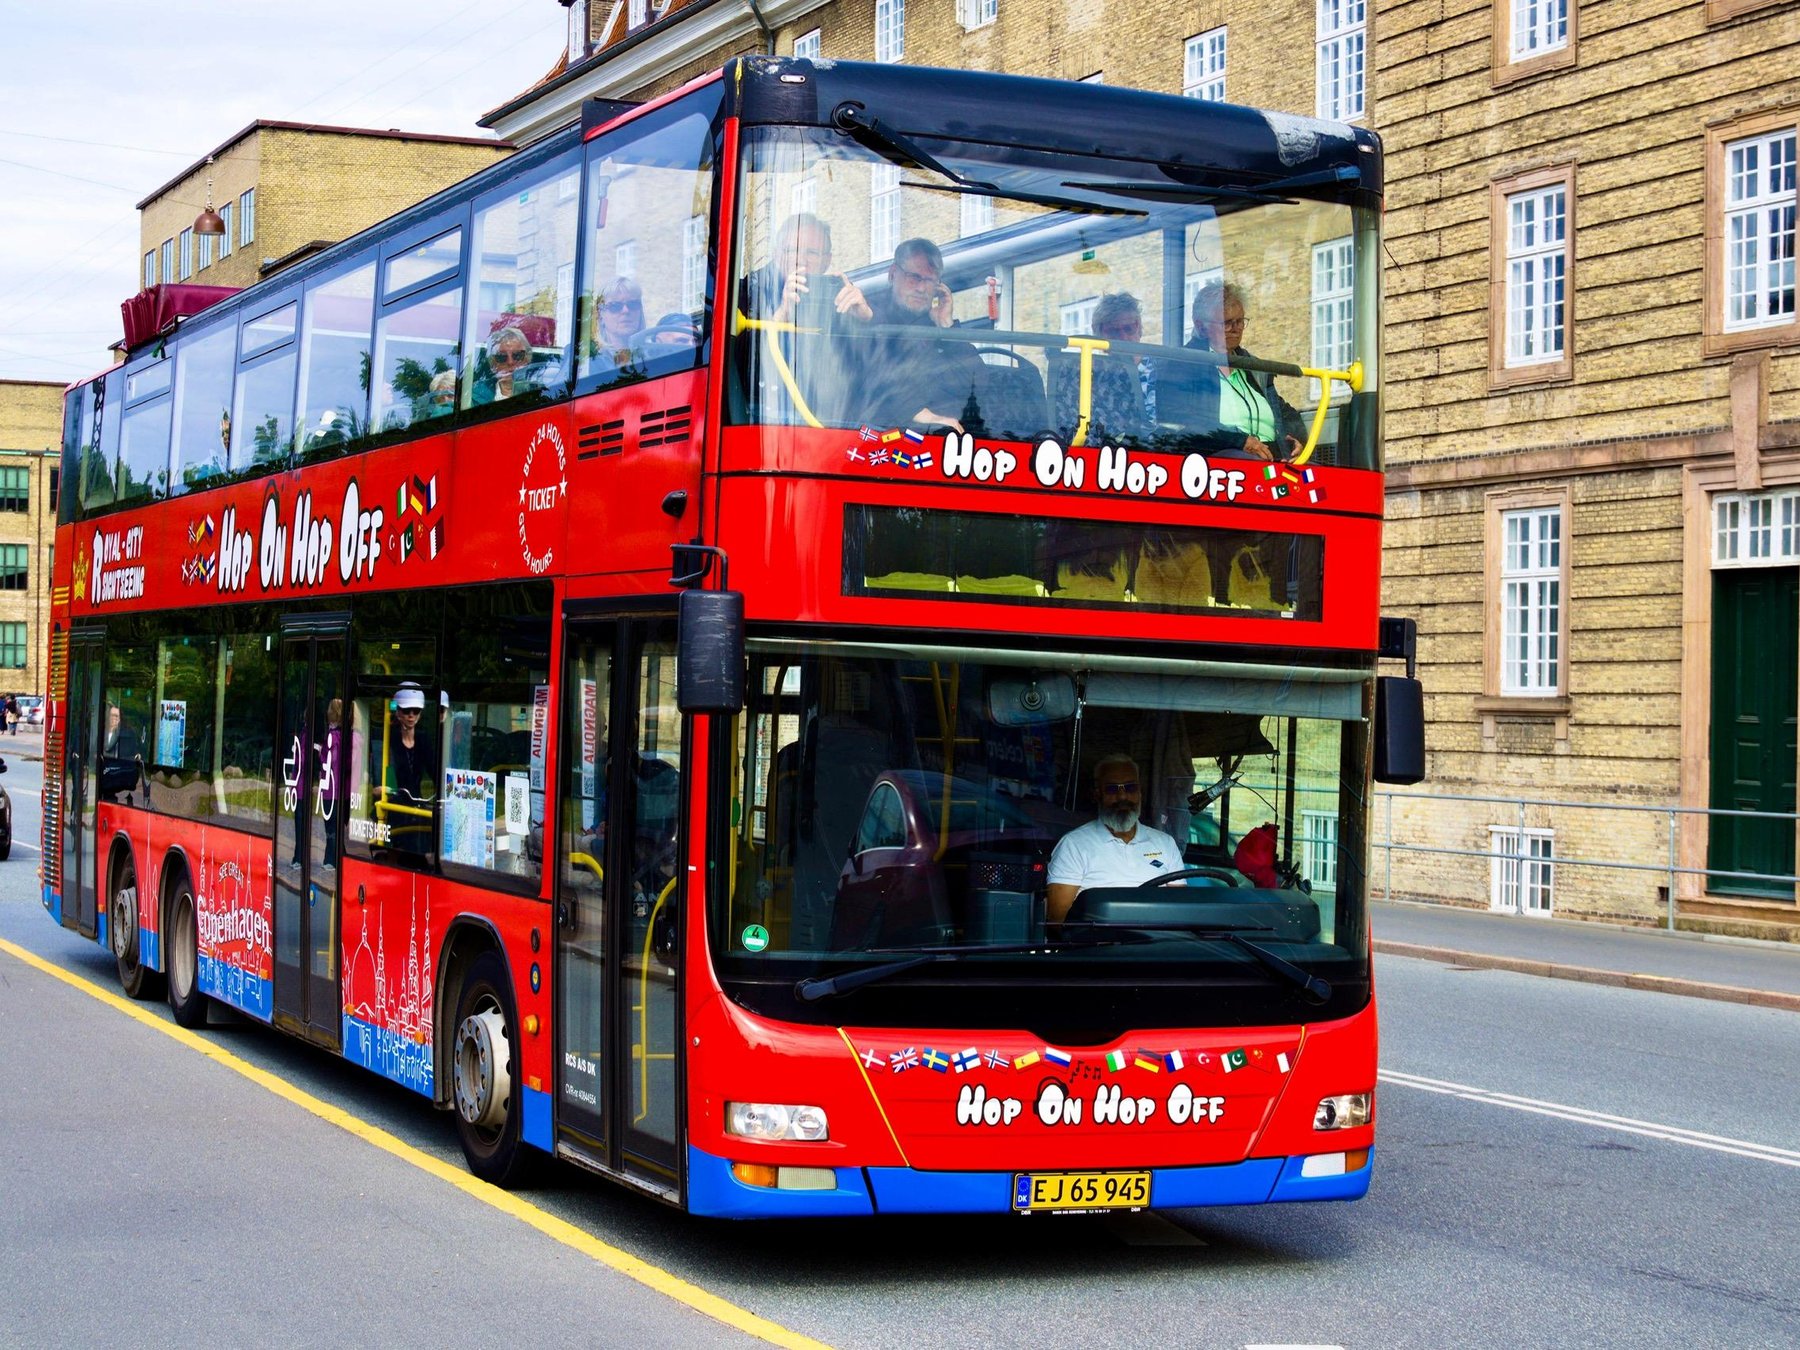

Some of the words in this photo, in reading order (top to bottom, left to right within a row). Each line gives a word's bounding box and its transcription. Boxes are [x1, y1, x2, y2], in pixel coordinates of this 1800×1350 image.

[523, 437, 536, 477] BUY
[537, 423, 546, 445] 24
[546, 423, 567, 471] HOURS
[528, 485, 557, 512] TICKET
[126, 526, 144, 560] CITY
[518, 512, 527, 546] GET
[523, 545, 531, 566] 24
[530, 548, 553, 575] HOURS
[102, 566, 145, 602] SIGHTSEEING
[350, 792, 363, 811] BUY
[350, 818, 374, 839] TICKETS
[374, 823, 391, 843] HERE
[219, 861, 228, 882] SEE
[228, 861, 244, 889] GREAT
[197, 894, 270, 951] Copenhagen
[752, 926, 760, 939] 4
[588, 1062, 596, 1076] DK
[1017, 1194, 1028, 1203] DK
[1034, 1179, 1064, 1203] EJ
[1070, 1177, 1098, 1203] 65
[1105, 1177, 1146, 1202] 945
